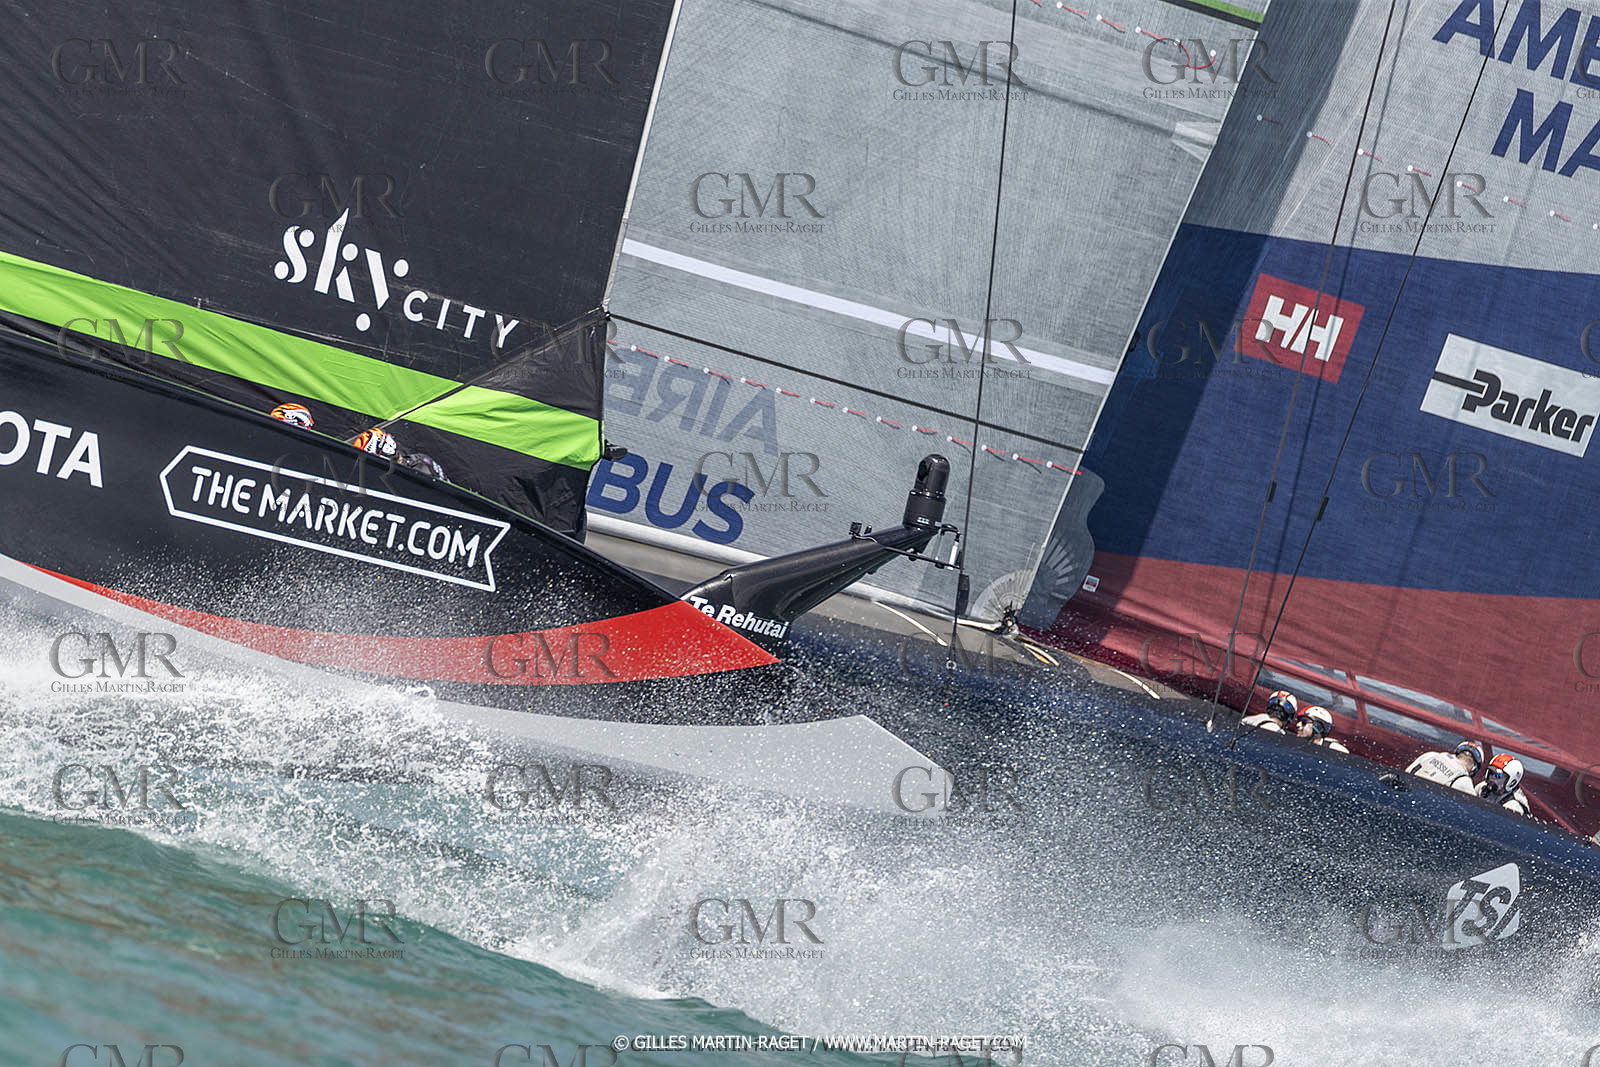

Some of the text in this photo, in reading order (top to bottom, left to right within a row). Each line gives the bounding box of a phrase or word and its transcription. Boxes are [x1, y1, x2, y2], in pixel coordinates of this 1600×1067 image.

[1491, 88, 1600, 178] MA
[403, 290, 520, 349] CITY
[1461, 369, 1597, 443] Parker
[0, 411, 103, 488] OTA
[192, 466, 480, 568] THE MARKET.COM
[585, 452, 756, 545] BUS
[690, 596, 789, 639] Te Rehutai
